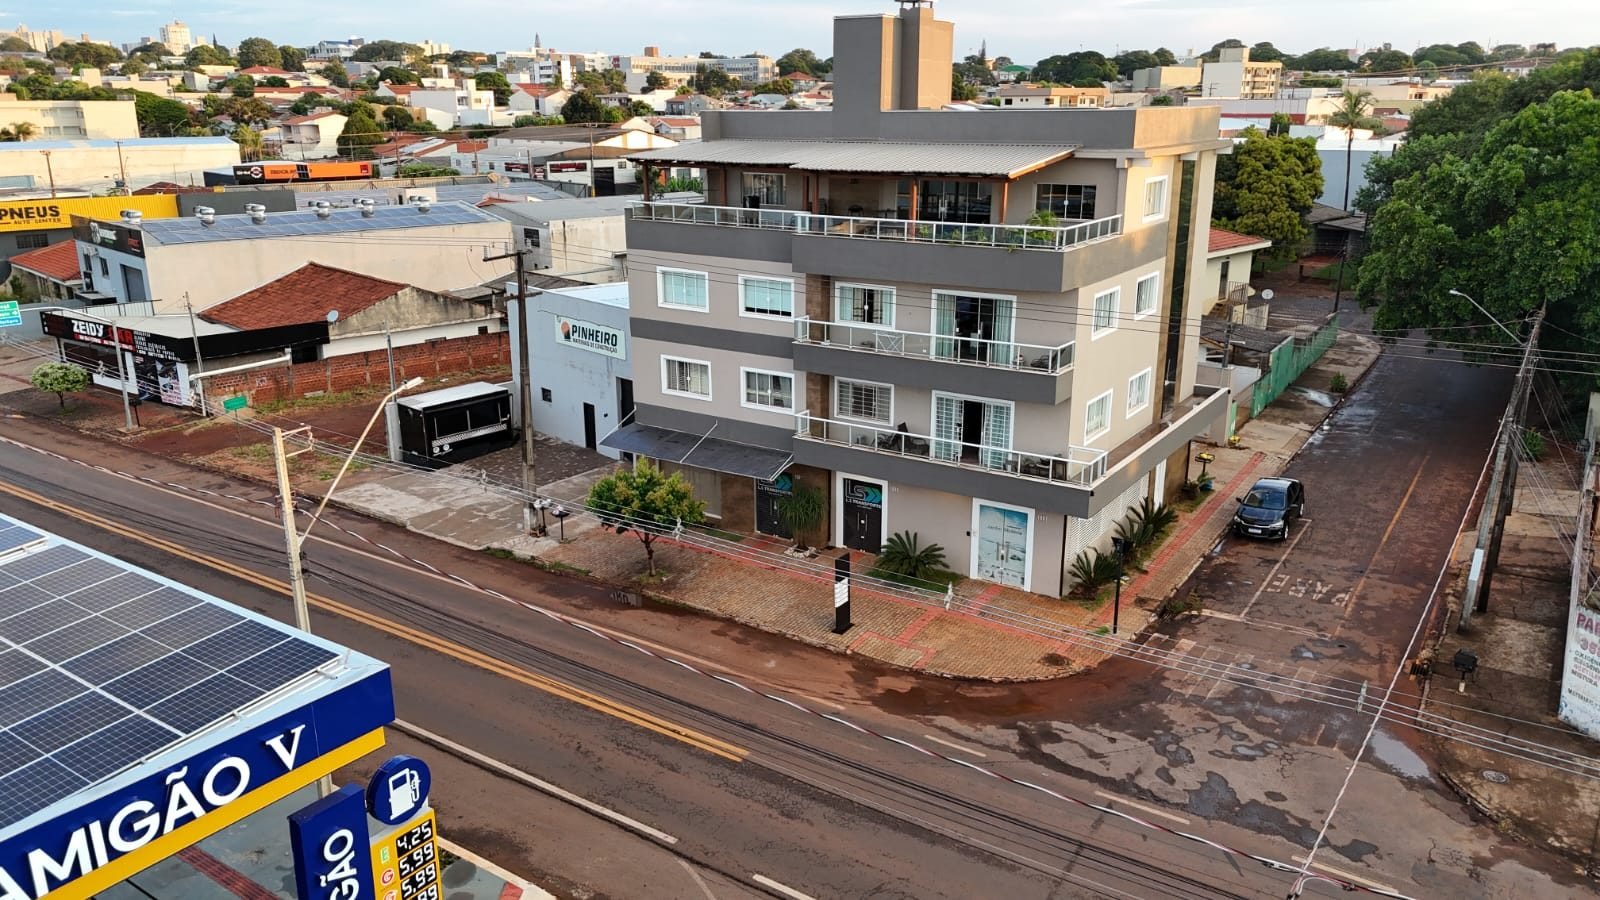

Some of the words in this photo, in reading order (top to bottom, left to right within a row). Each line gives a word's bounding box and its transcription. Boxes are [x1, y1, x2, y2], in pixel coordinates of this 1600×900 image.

[0, 205, 60, 220] PNEUS
[71, 319, 104, 336] ZEIDY
[571, 324, 618, 347] PINHEIRO
[1266, 574, 1353, 607] PARE
[266, 724, 306, 770] V
